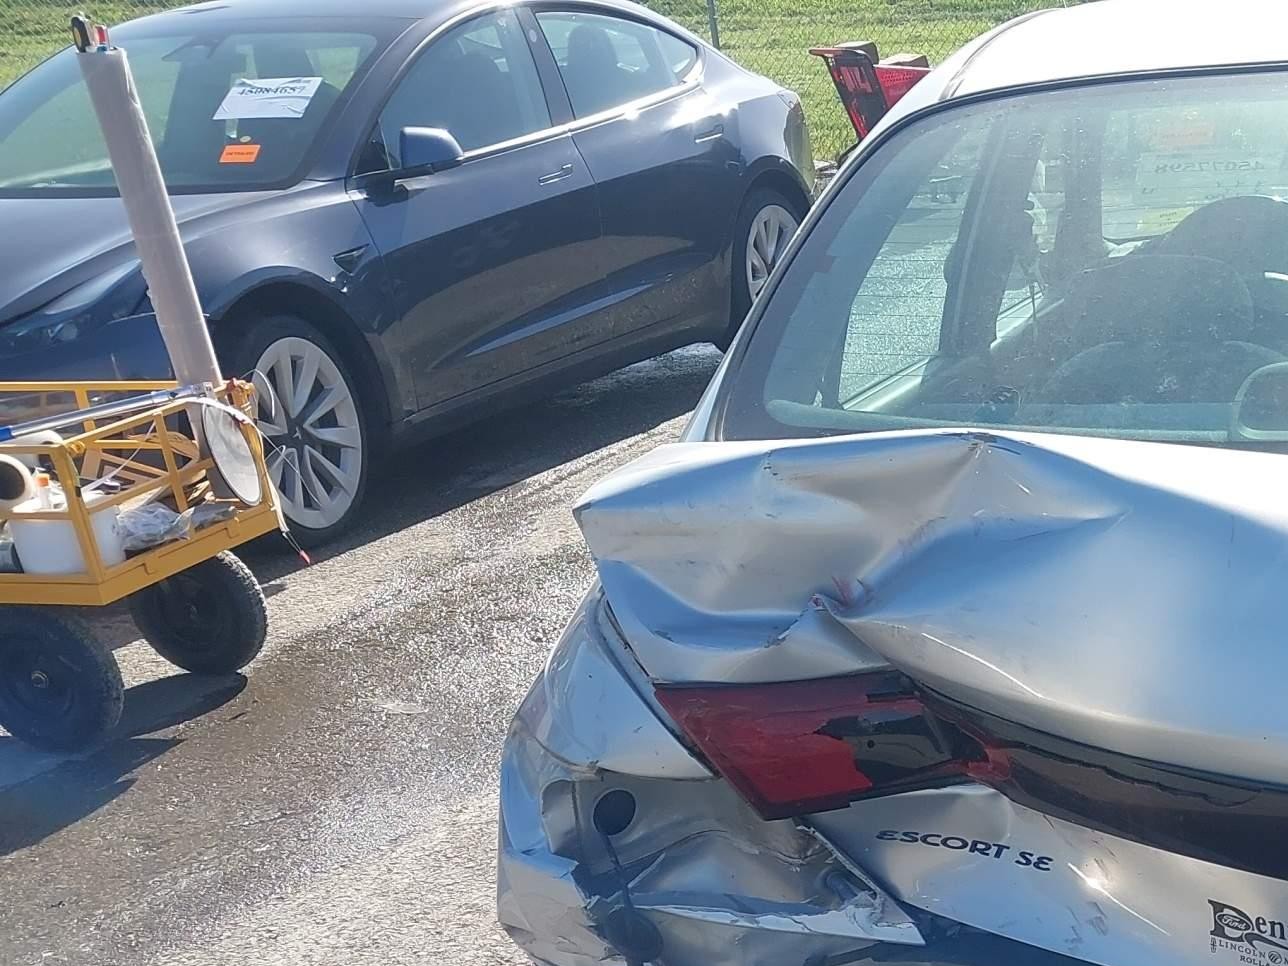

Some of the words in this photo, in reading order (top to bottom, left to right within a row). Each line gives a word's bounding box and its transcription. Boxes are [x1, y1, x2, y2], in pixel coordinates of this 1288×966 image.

[876, 830, 1010, 859] ESCORT
[1015, 851, 1053, 871] SE
[1219, 939, 1266, 958] LINCOLN
